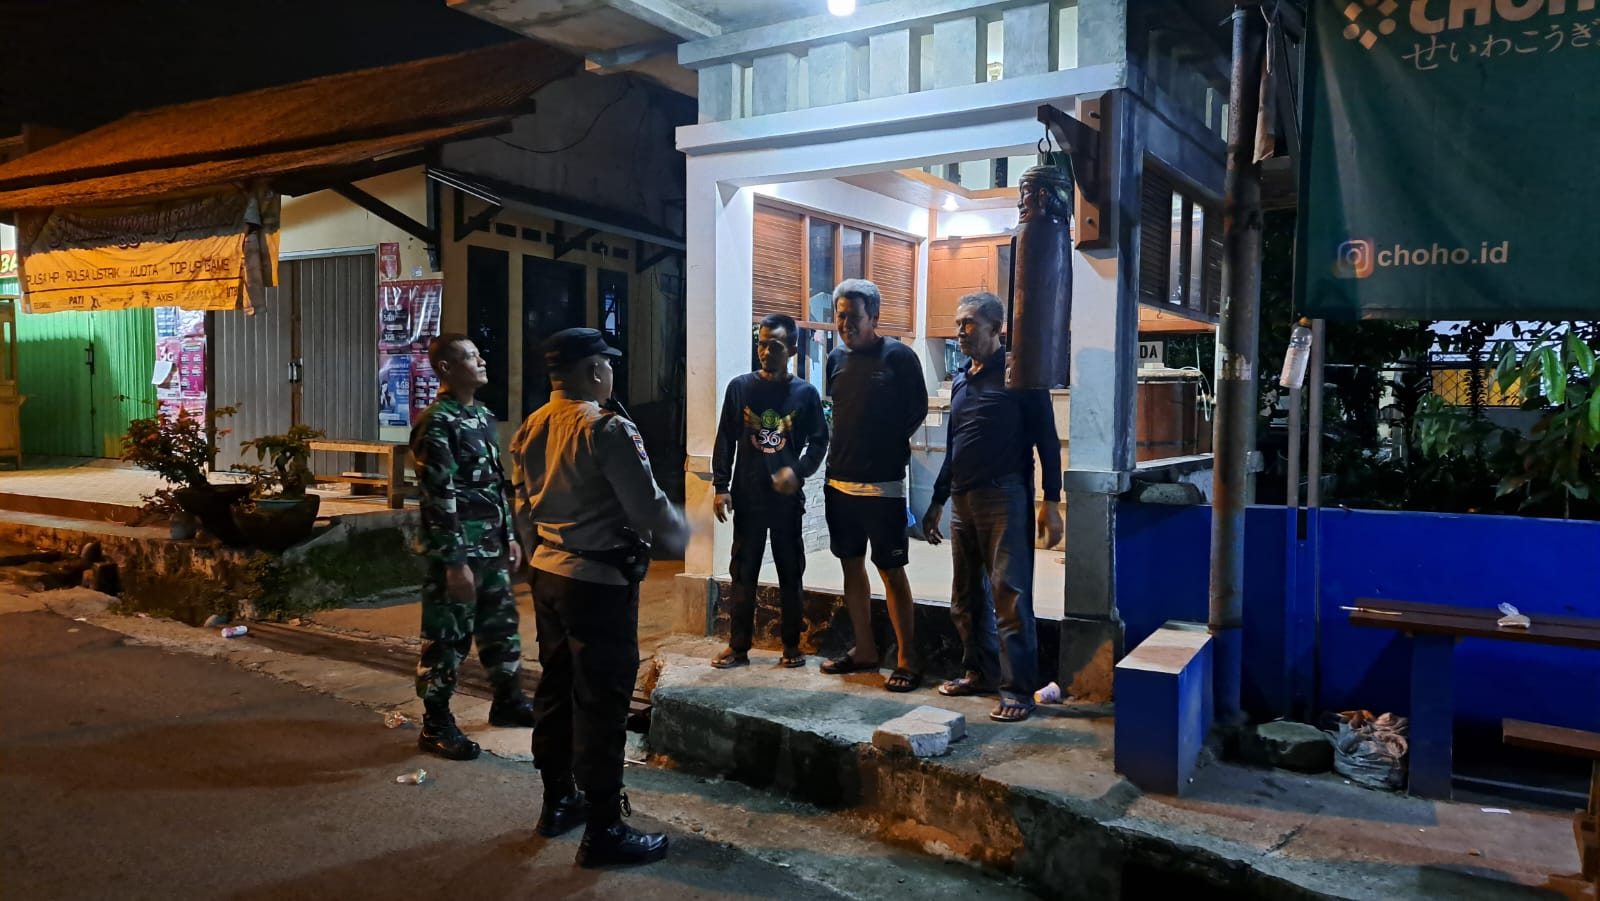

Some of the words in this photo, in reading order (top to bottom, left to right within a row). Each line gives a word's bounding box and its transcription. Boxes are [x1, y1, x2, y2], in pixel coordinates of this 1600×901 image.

[1377, 241, 1509, 267] choho.id
[48, 271, 60, 284] HP
[66, 268, 91, 282] PULSA
[91, 266, 121, 281] LISTRIK
[129, 263, 159, 278] KUOTA
[169, 260, 187, 275] TOP
[189, 259, 202, 274] UP
[203, 257, 231, 273] GAME
[156, 293, 174, 302] AXIS
[1139, 344, 1158, 359] DA
[758, 428, 782, 446] 56
